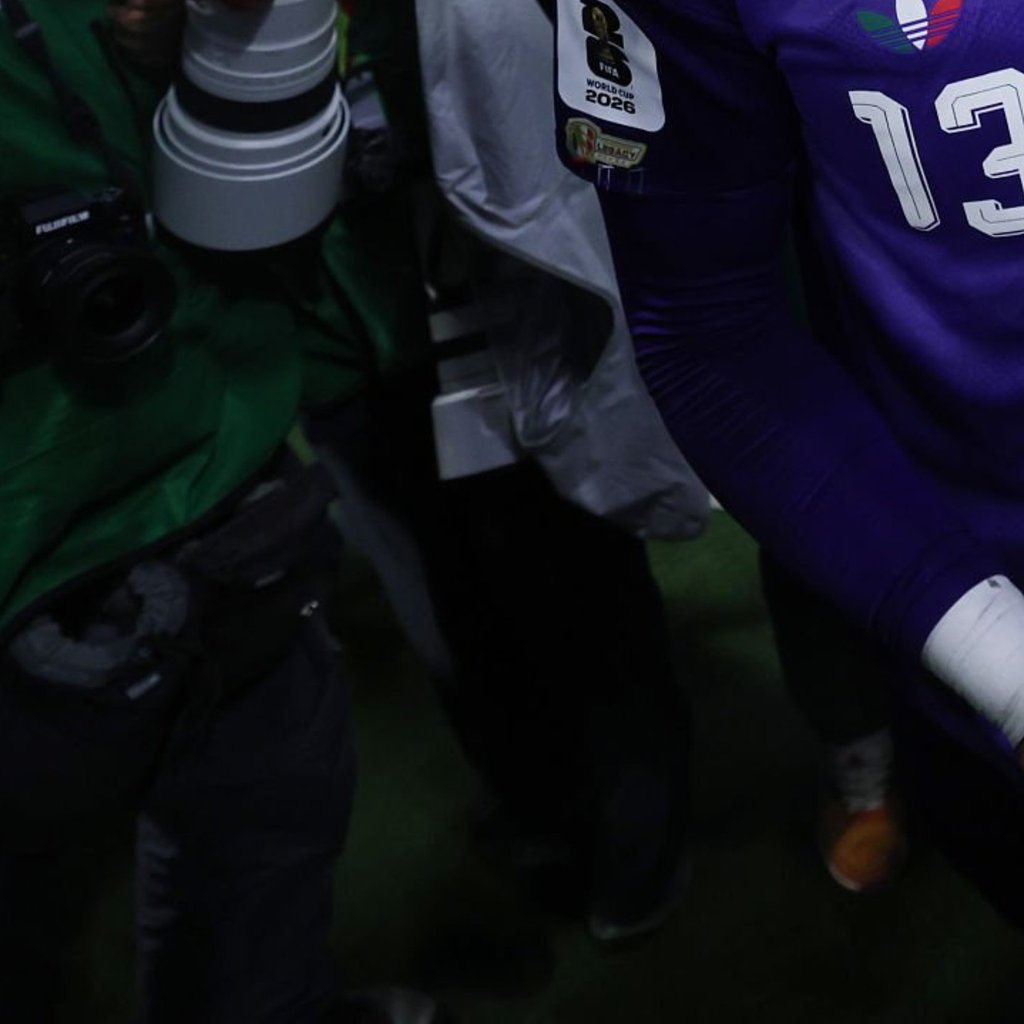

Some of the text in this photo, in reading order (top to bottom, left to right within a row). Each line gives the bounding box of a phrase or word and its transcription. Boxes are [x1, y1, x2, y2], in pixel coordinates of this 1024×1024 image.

[586, 77, 635, 101] WORLD CUP
[585, 89, 637, 115] 2026
